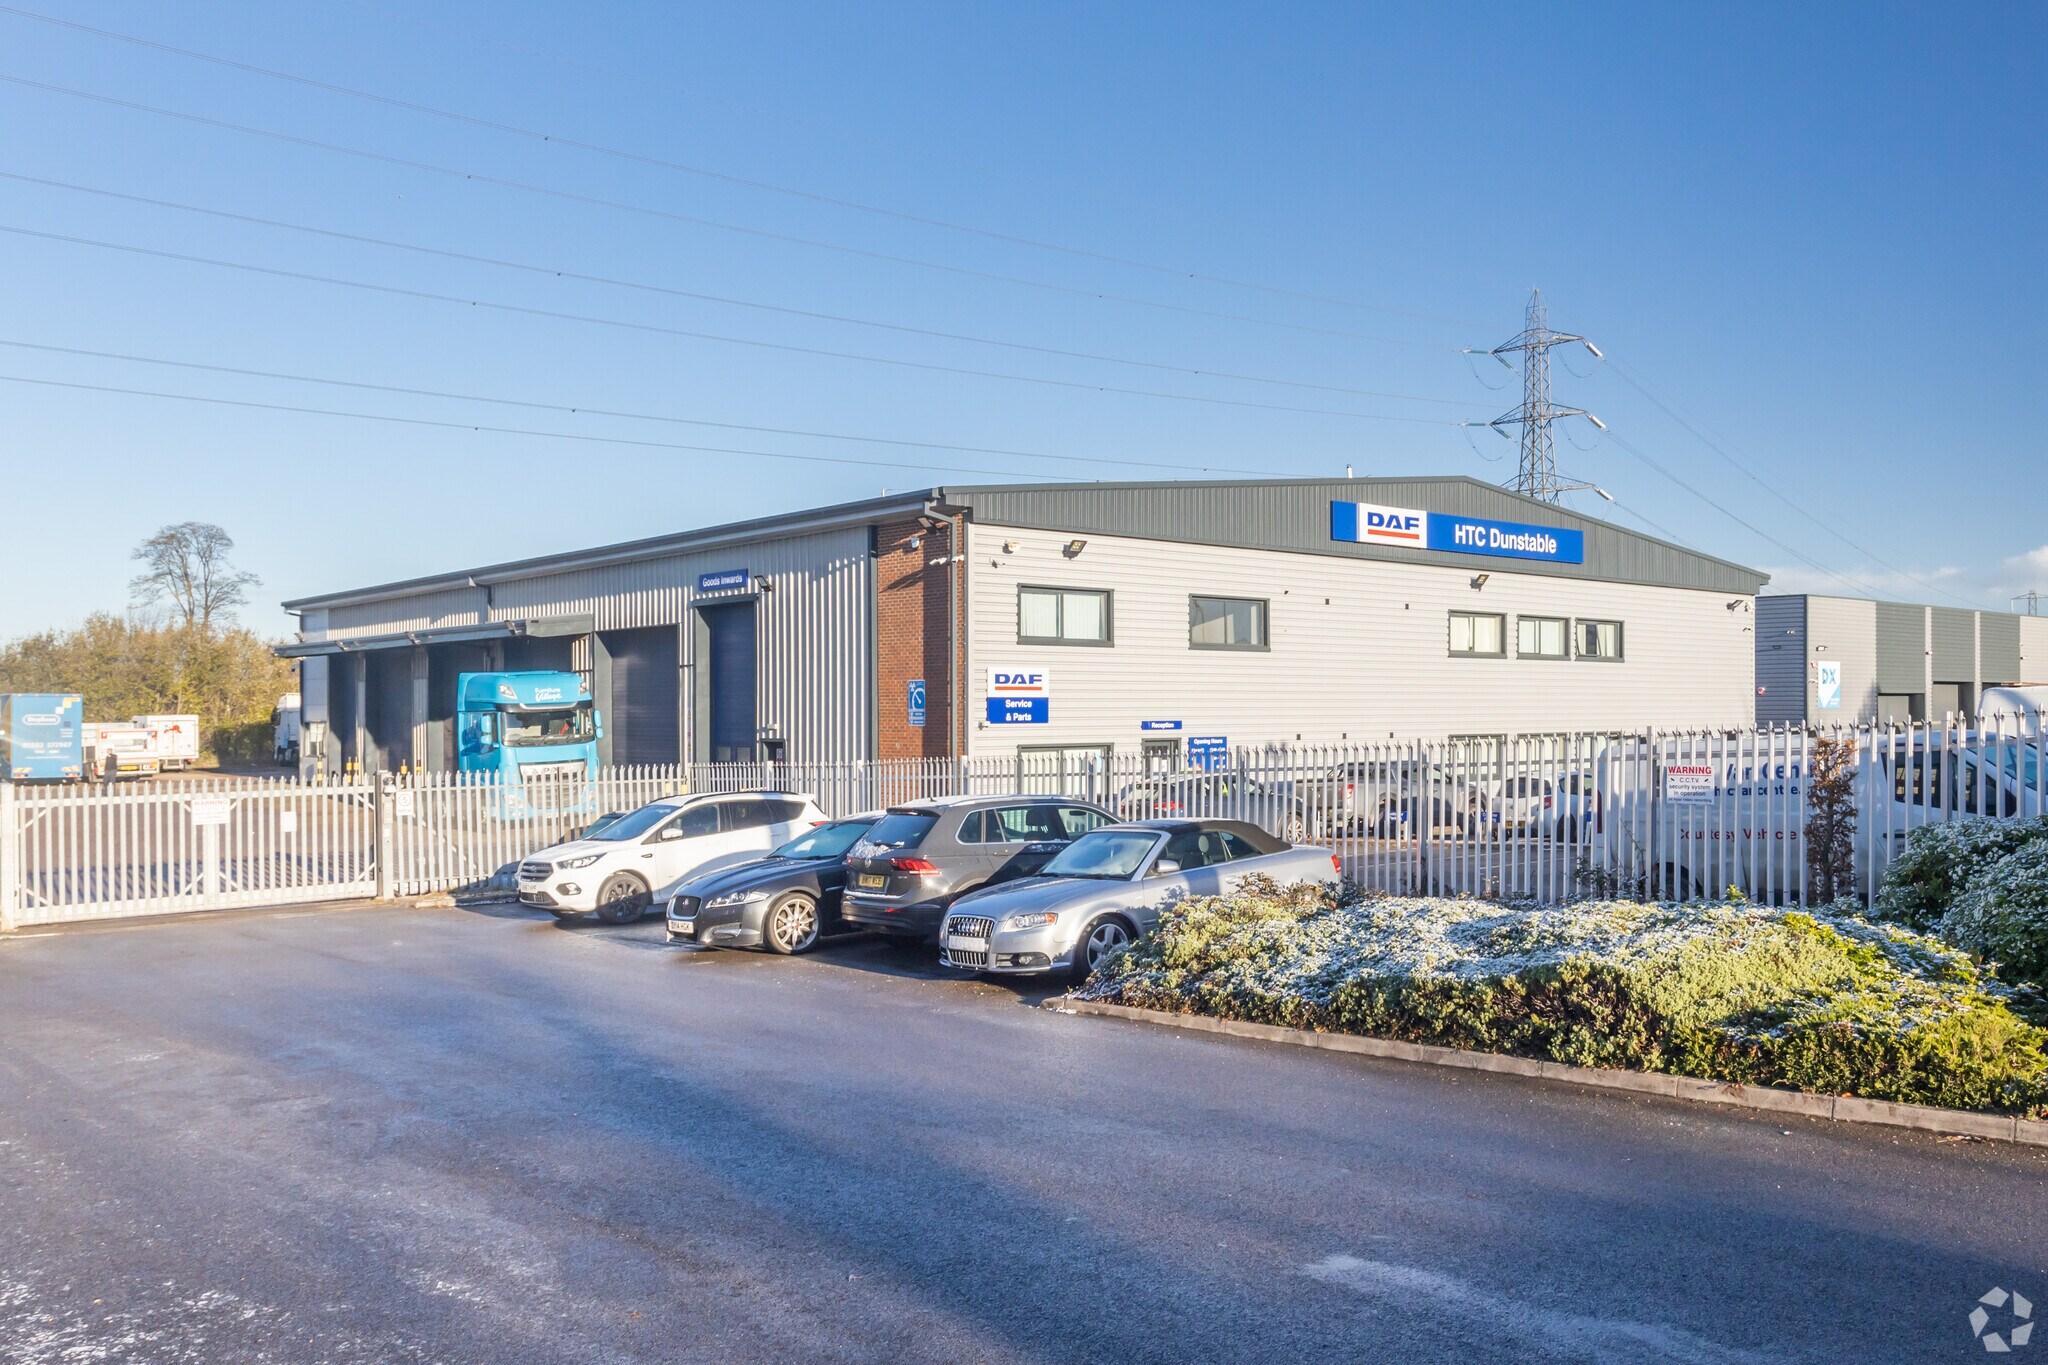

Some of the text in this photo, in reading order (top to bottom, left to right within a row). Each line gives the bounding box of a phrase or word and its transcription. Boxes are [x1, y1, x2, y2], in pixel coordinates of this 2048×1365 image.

[1367, 511, 1420, 531] DAF
[1454, 523, 1557, 554] HTC Dunstable
[702, 574, 743, 587] Goods inwards
[994, 674, 1043, 684] DAF
[1822, 668, 1836, 685] DX
[535, 692, 563, 702] Village
[1005, 699, 1032, 708] Service
[1005, 713, 1032, 721] & Parts
[1668, 766, 1712, 774] WARNING
[1680, 828, 1736, 843] outesy
[1743, 828, 1797, 840] Vhce
